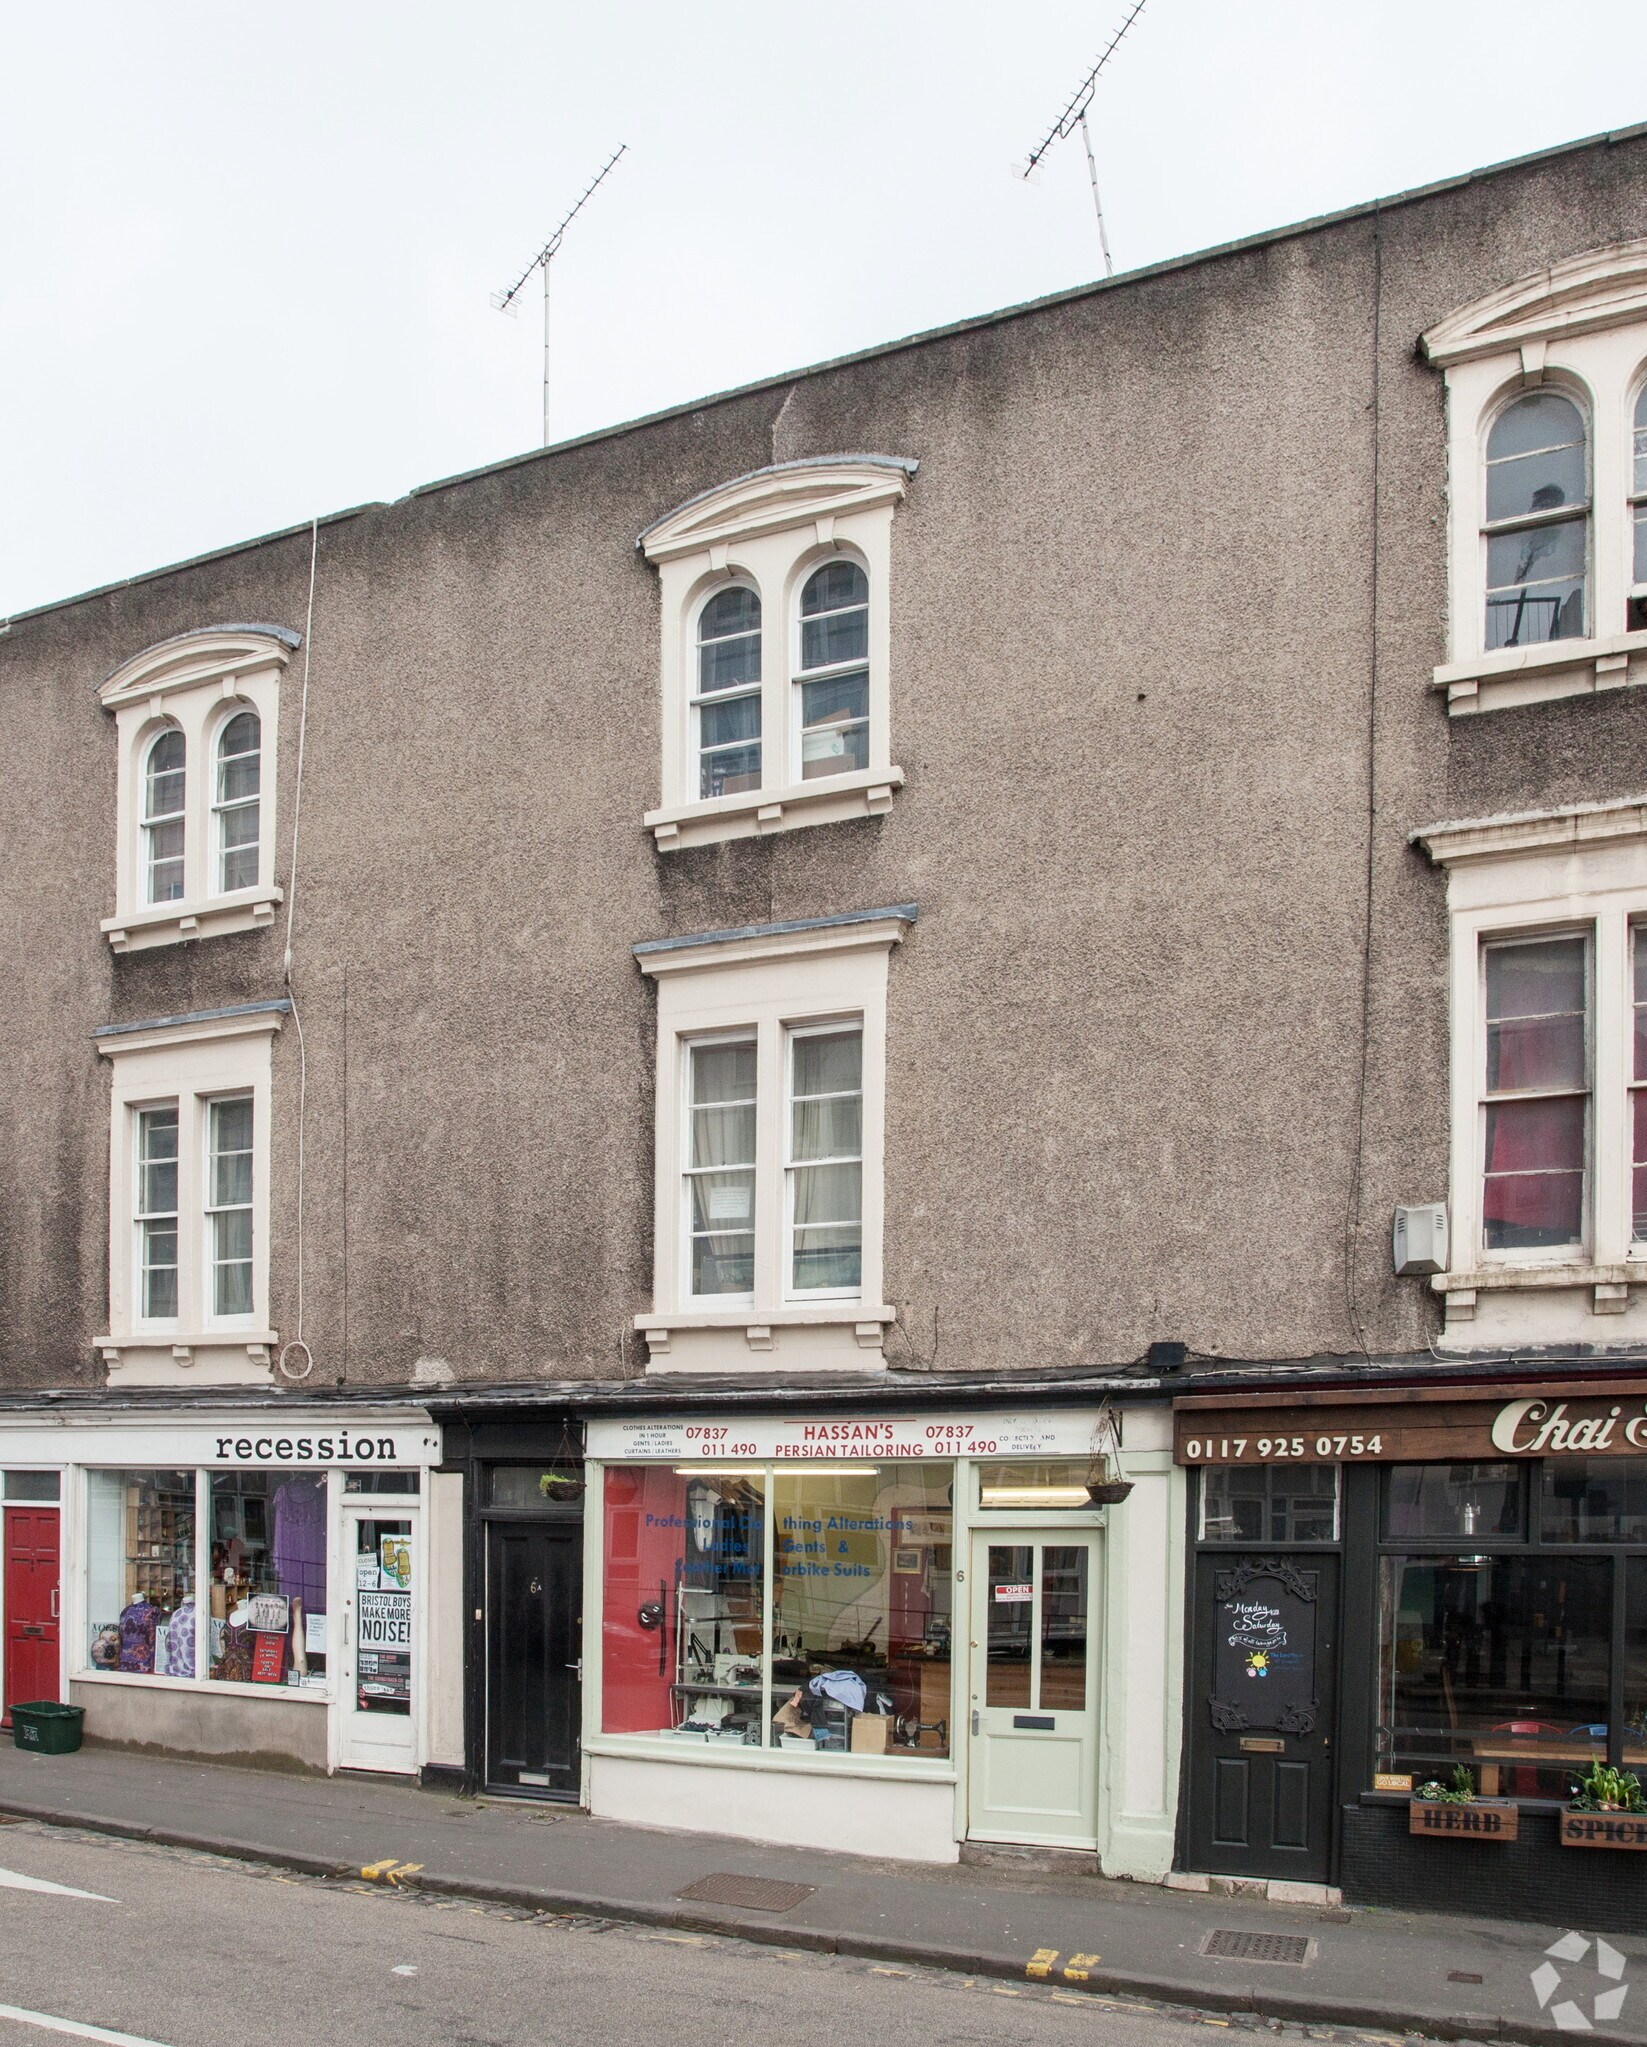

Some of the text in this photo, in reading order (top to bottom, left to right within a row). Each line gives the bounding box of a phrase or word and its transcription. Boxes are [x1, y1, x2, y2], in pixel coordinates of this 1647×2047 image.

[804, 1423, 894, 1440] HASSAN'S
[926, 1426, 974, 1438] 07837
[1492, 1398, 1622, 1453] Chai
[686, 1427, 729, 1440] 07837
[216, 1431, 396, 1460] recession
[702, 1444, 756, 1455] 011 490
[776, 1444, 924, 1456] PERSIAN TAILORING
[934, 1440, 997, 1454] 011 490
[1186, 1436, 1382, 1459] 0117 925 0754
[782, 1516, 822, 1532] thing
[827, 1516, 913, 1530] Alterations
[782, 1539, 825, 1552] Gents
[838, 1540, 848, 1553] &
[782, 1563, 830, 1576] orbike
[834, 1562, 870, 1576] Suits
[957, 1570, 964, 1582] 6
[362, 1595, 411, 1607] BRISTOL BOYS
[362, 1606, 411, 1620] MAKE MORE
[1232, 1601, 1272, 1620] Monday
[362, 1620, 410, 1643] NOISE!
[1233, 1615, 1284, 1634] Saturday
[1424, 1810, 1501, 1833] HERB
